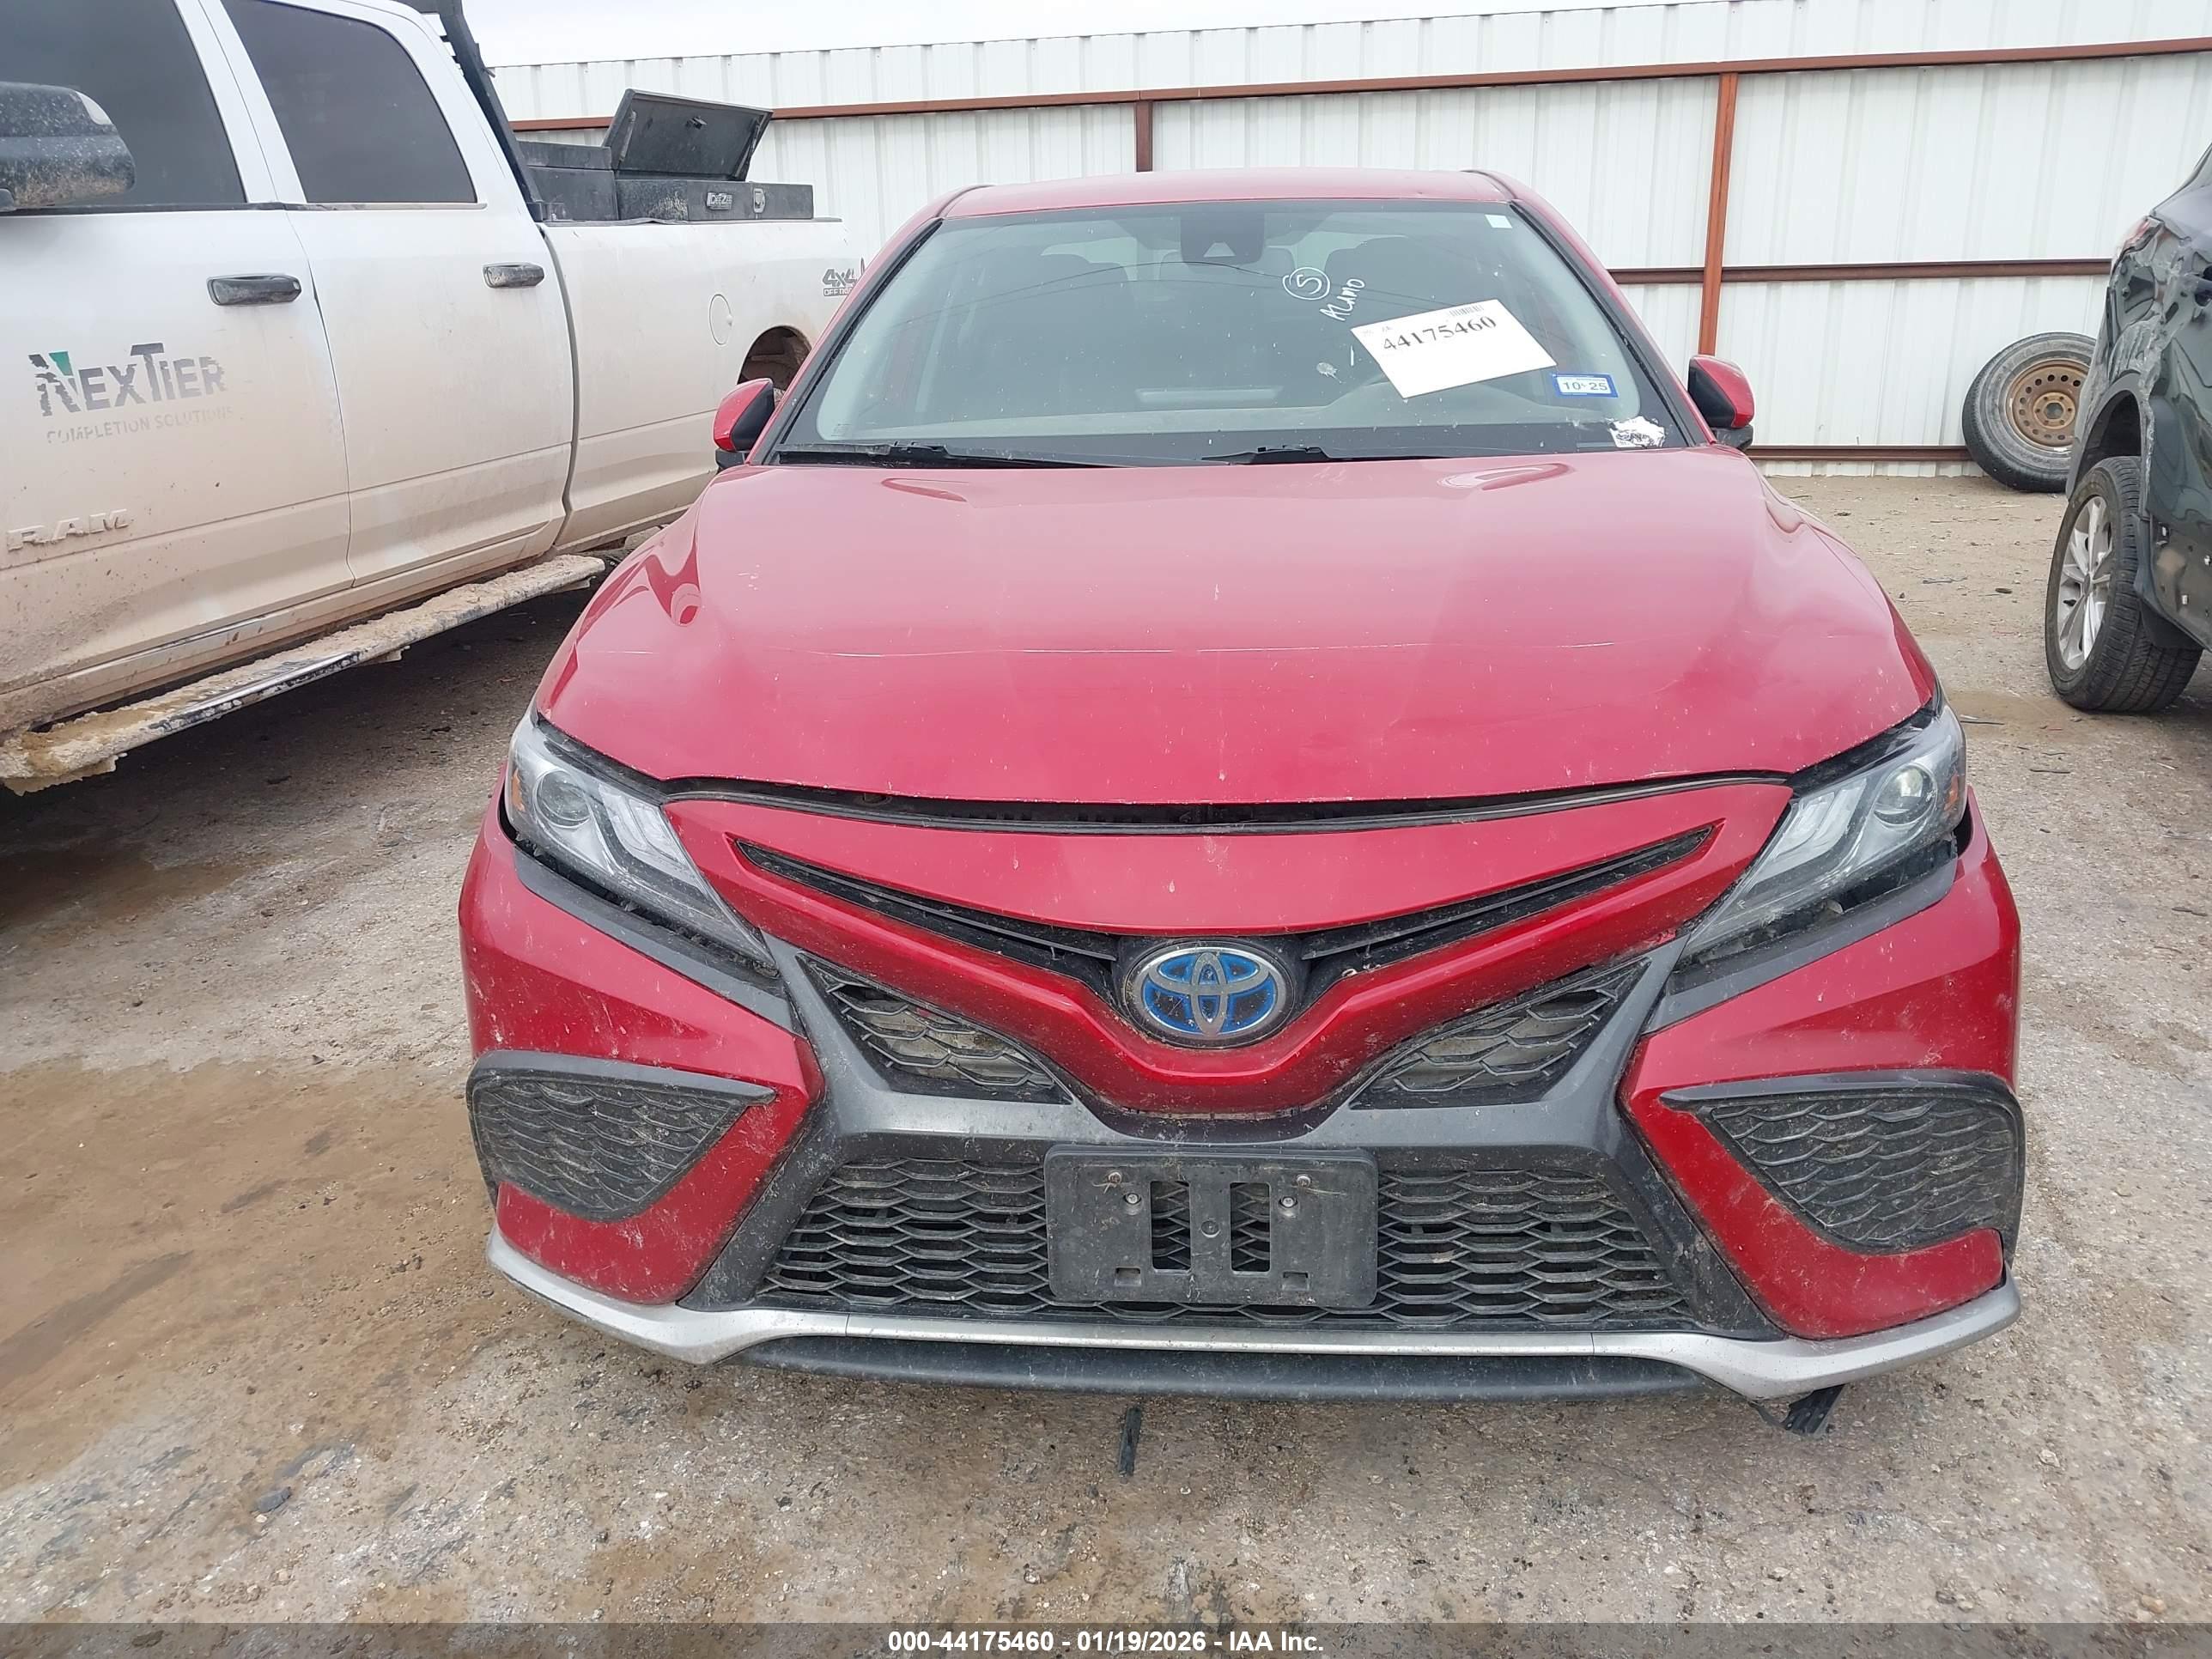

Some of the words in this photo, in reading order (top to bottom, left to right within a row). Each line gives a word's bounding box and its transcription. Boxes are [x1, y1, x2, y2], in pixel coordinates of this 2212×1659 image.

[1382, 315, 1497, 350] 44175460
[1563, 382, 1582, 391] 10
[1589, 382, 1608, 392] 25
[7, 508, 129, 551] RAM
